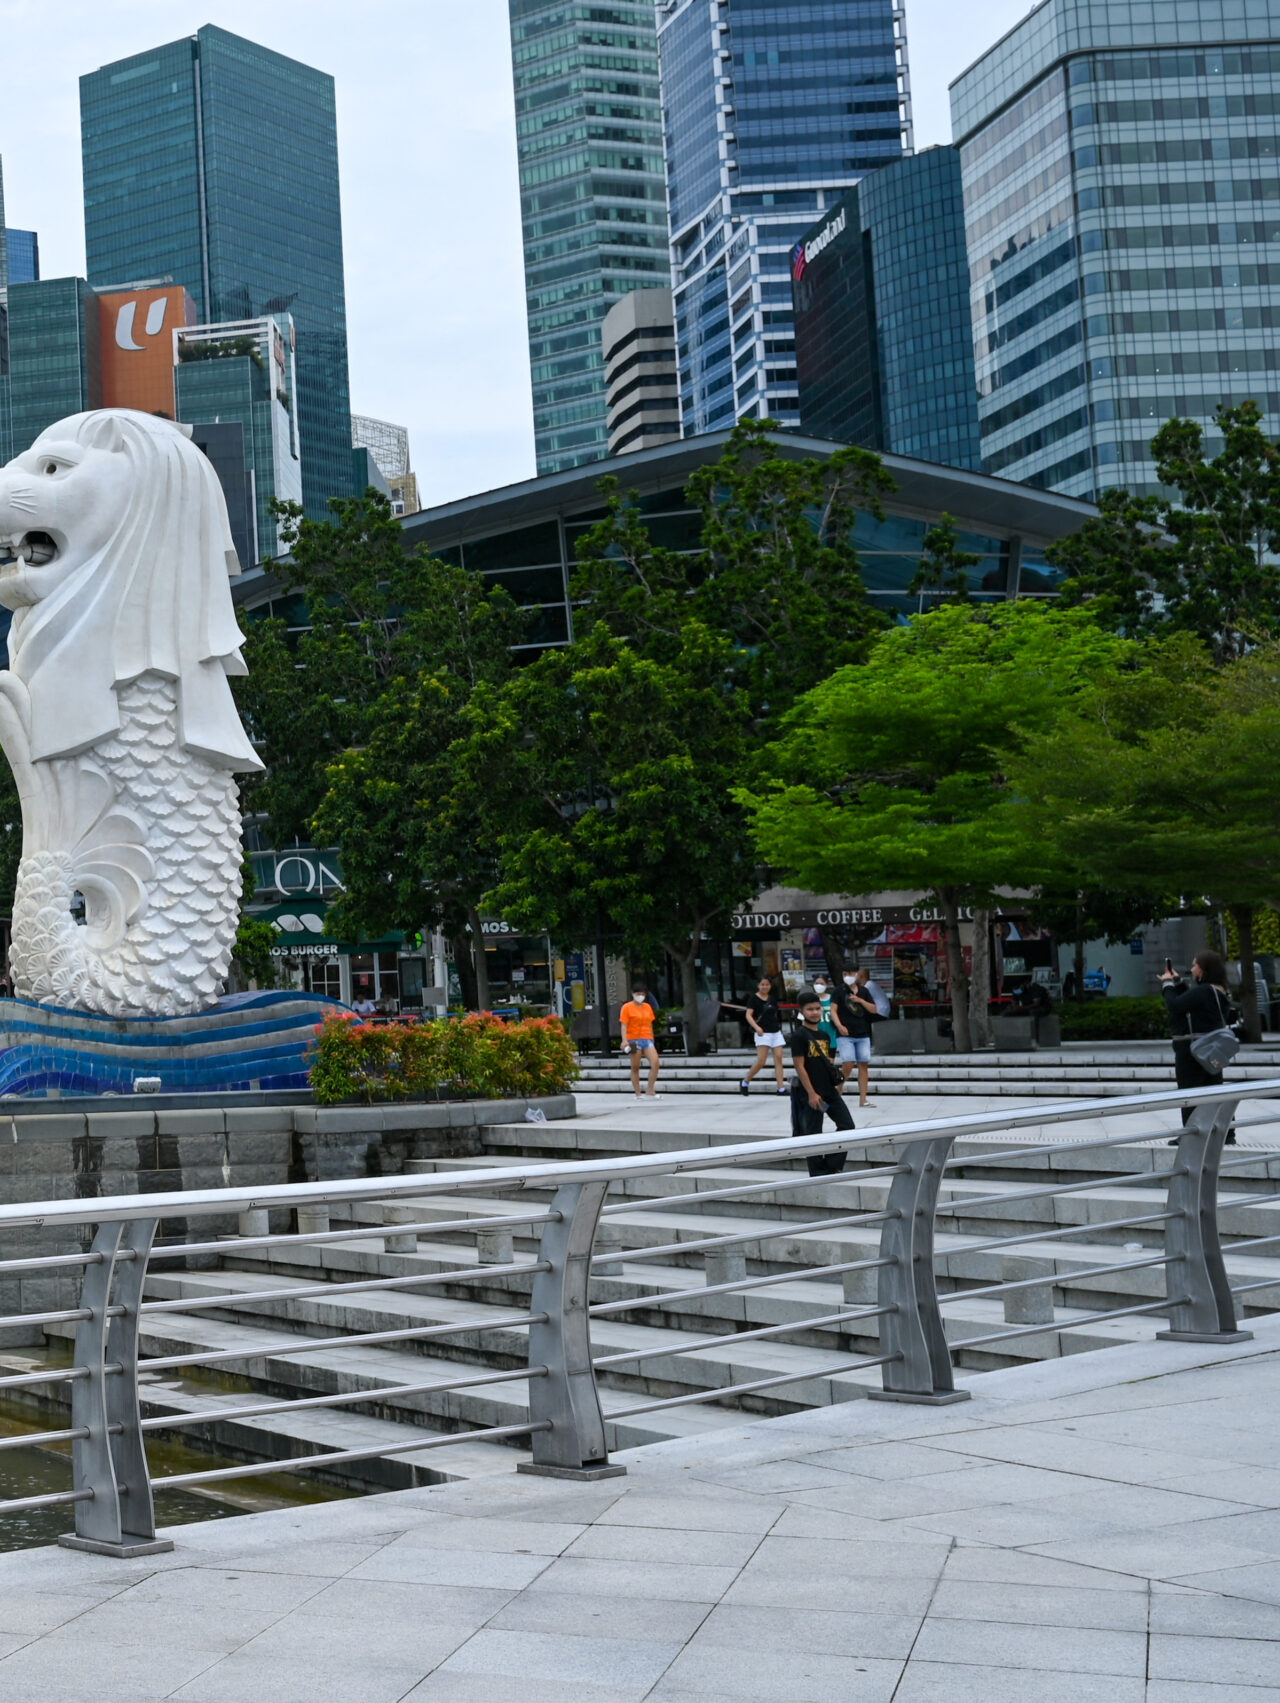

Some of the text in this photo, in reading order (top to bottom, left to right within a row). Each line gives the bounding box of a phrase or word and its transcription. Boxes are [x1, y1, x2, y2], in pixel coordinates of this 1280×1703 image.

[730, 912, 791, 929] OTDOG
[816, 909, 883, 925] COFFEE
[269, 944, 338, 956] OS BURGER
